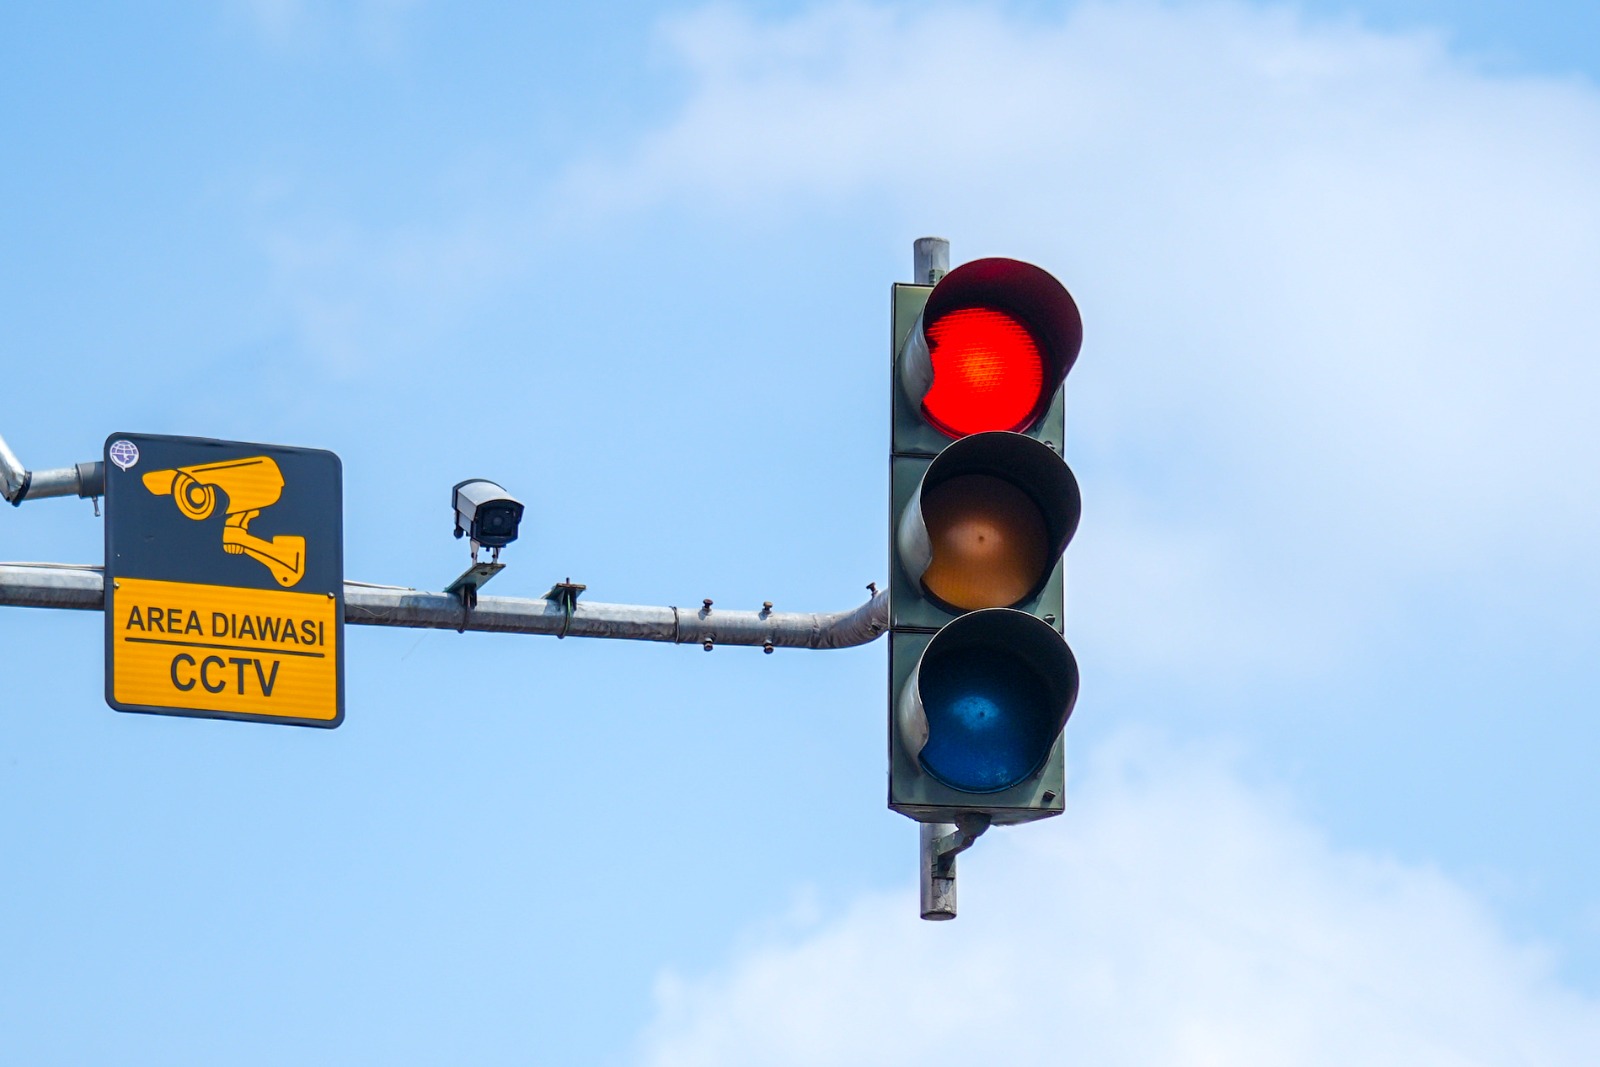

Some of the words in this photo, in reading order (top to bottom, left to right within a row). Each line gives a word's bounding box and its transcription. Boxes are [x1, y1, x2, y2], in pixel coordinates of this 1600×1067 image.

[126, 605, 204, 636] AREA
[212, 612, 324, 646] DIAWASI
[170, 653, 280, 697] CCTV
